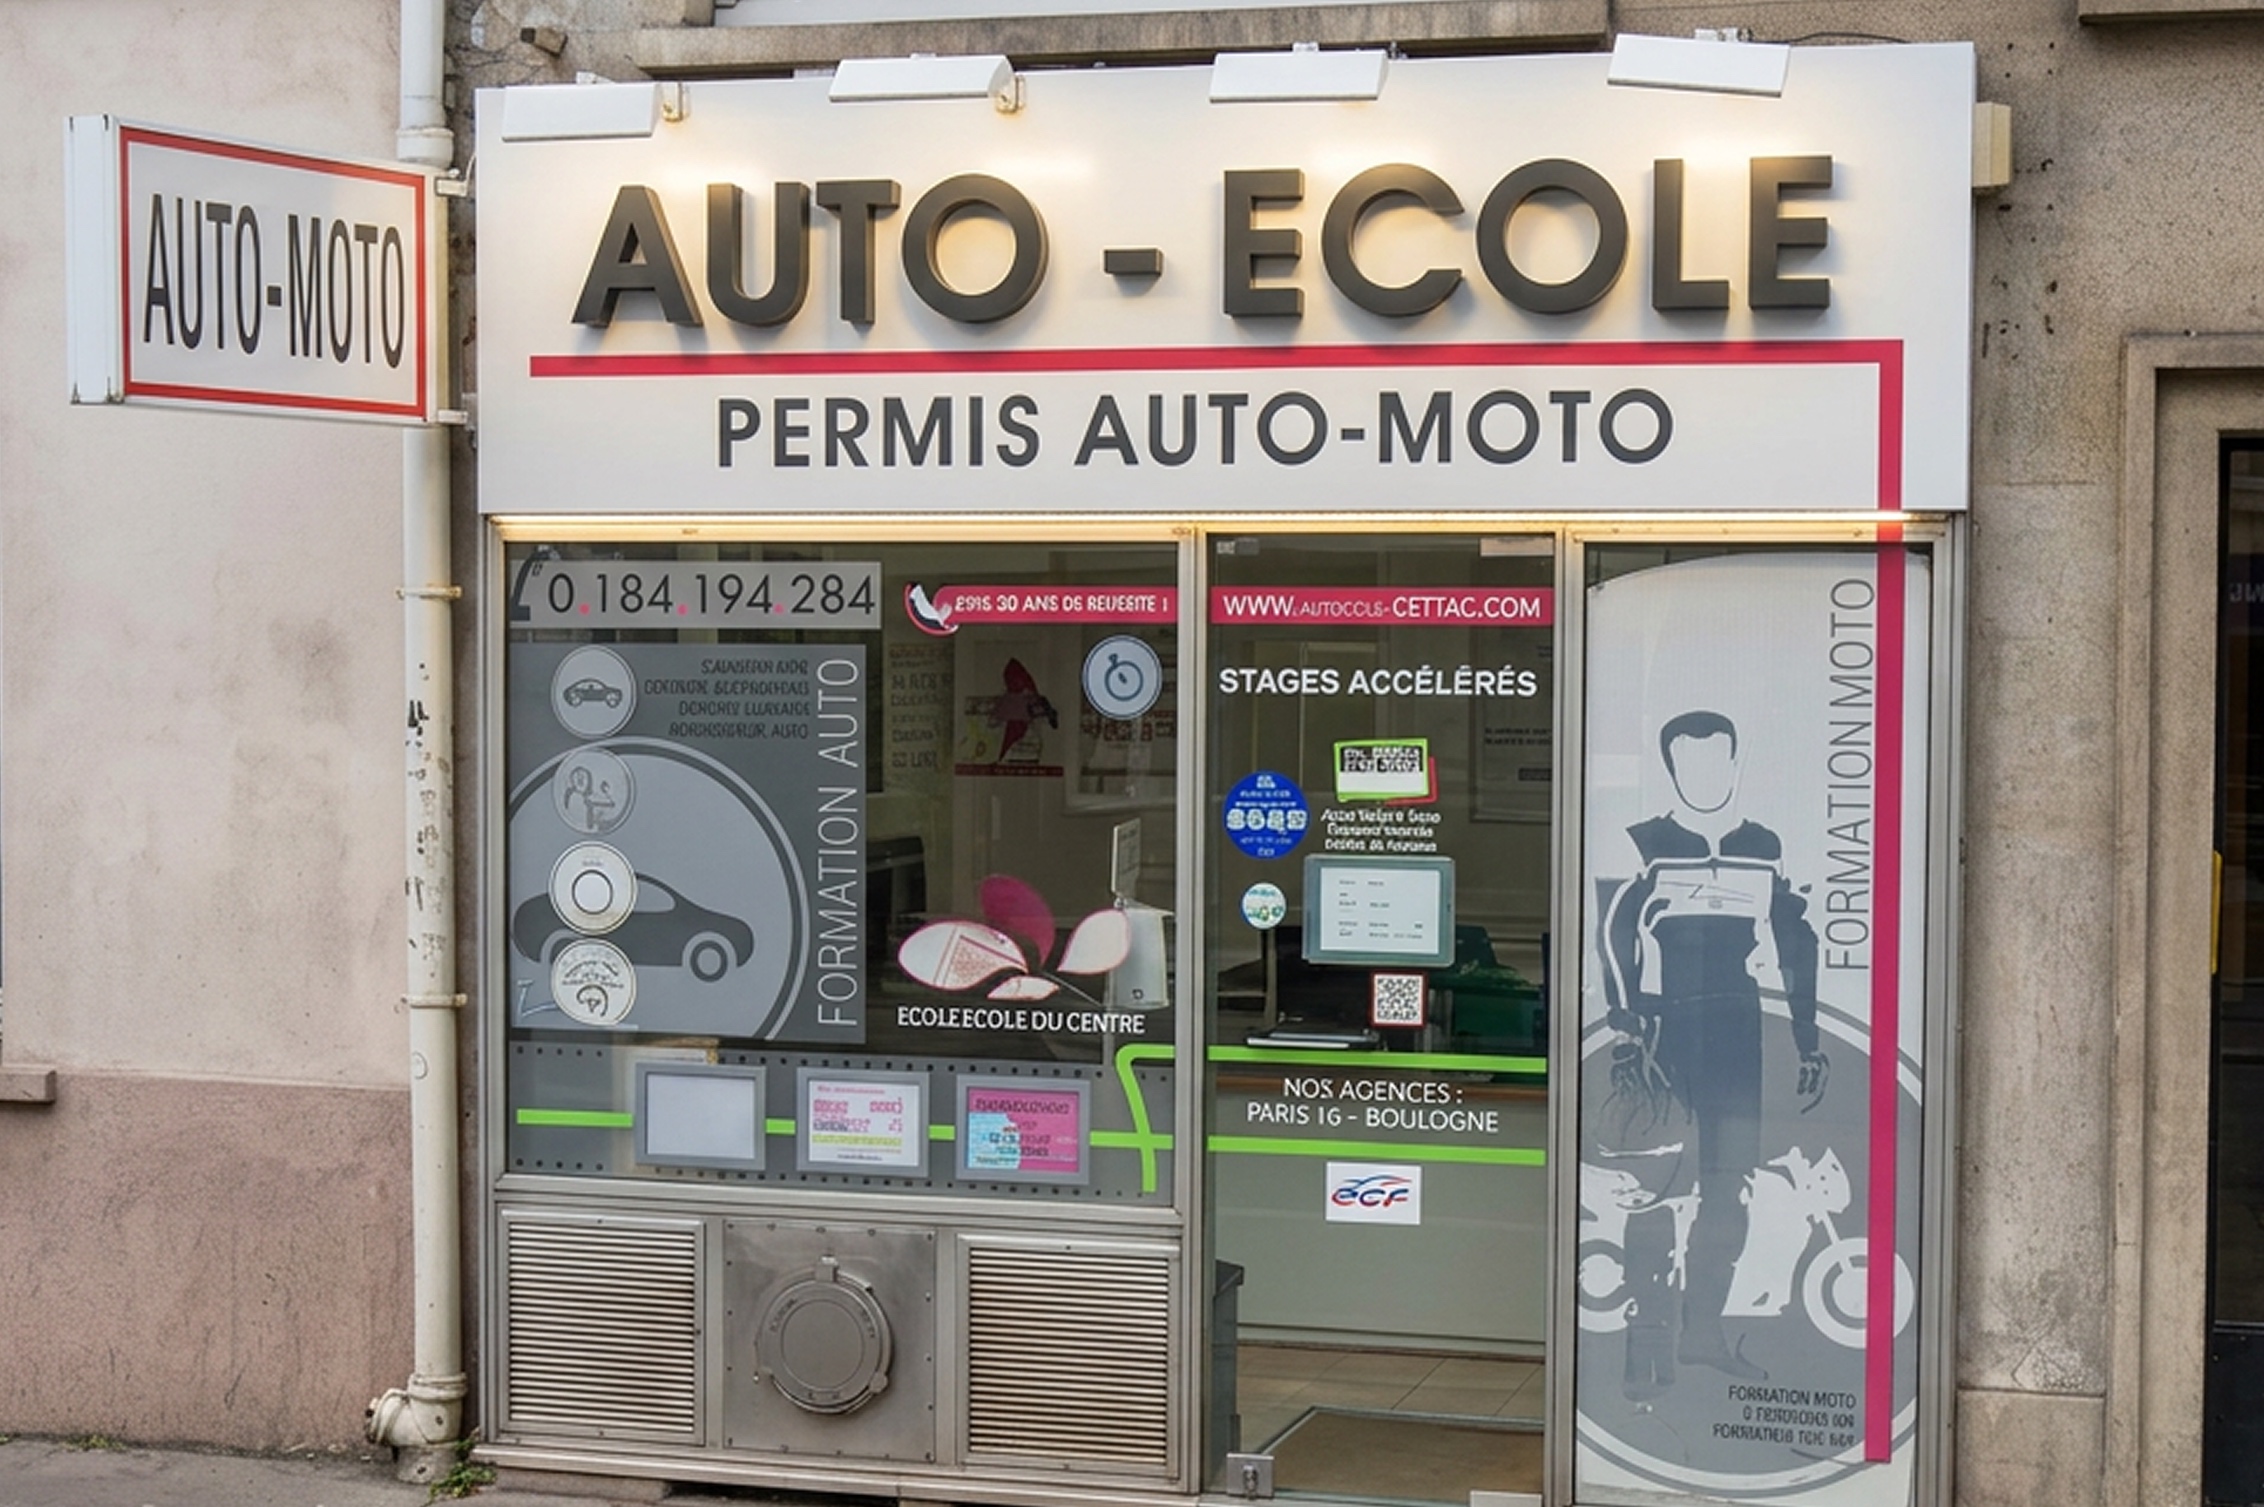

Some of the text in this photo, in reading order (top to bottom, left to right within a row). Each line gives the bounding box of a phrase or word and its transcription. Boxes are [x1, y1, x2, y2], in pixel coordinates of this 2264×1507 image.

[571, 173, 1049, 327] AUTO
[1223, 154, 1834, 317] ECOLE
[143, 193, 405, 369] AUTO-MOTO
[718, 387, 1674, 468] PERMIS AUTO-MOTO
[996, 594, 1018, 612] 30
[1022, 595, 1059, 613] ANS
[1218, 663, 1538, 697] STAGES ACCÉLÉRÉS
[1825, 577, 1876, 970] FORMATION MOTO
[816, 658, 859, 1026] FORMATION AUTO
[1031, 1012, 1063, 1031] DU
[1066, 1013, 1146, 1035] CENTRE
[1283, 1077, 1334, 1099] NOS
[1338, 1080, 1451, 1104] AGENCES
[1246, 1102, 1311, 1126] PARIS
[1364, 1107, 1500, 1134] BOULOGNE
[1814, 1391, 1857, 1410] MOTO
